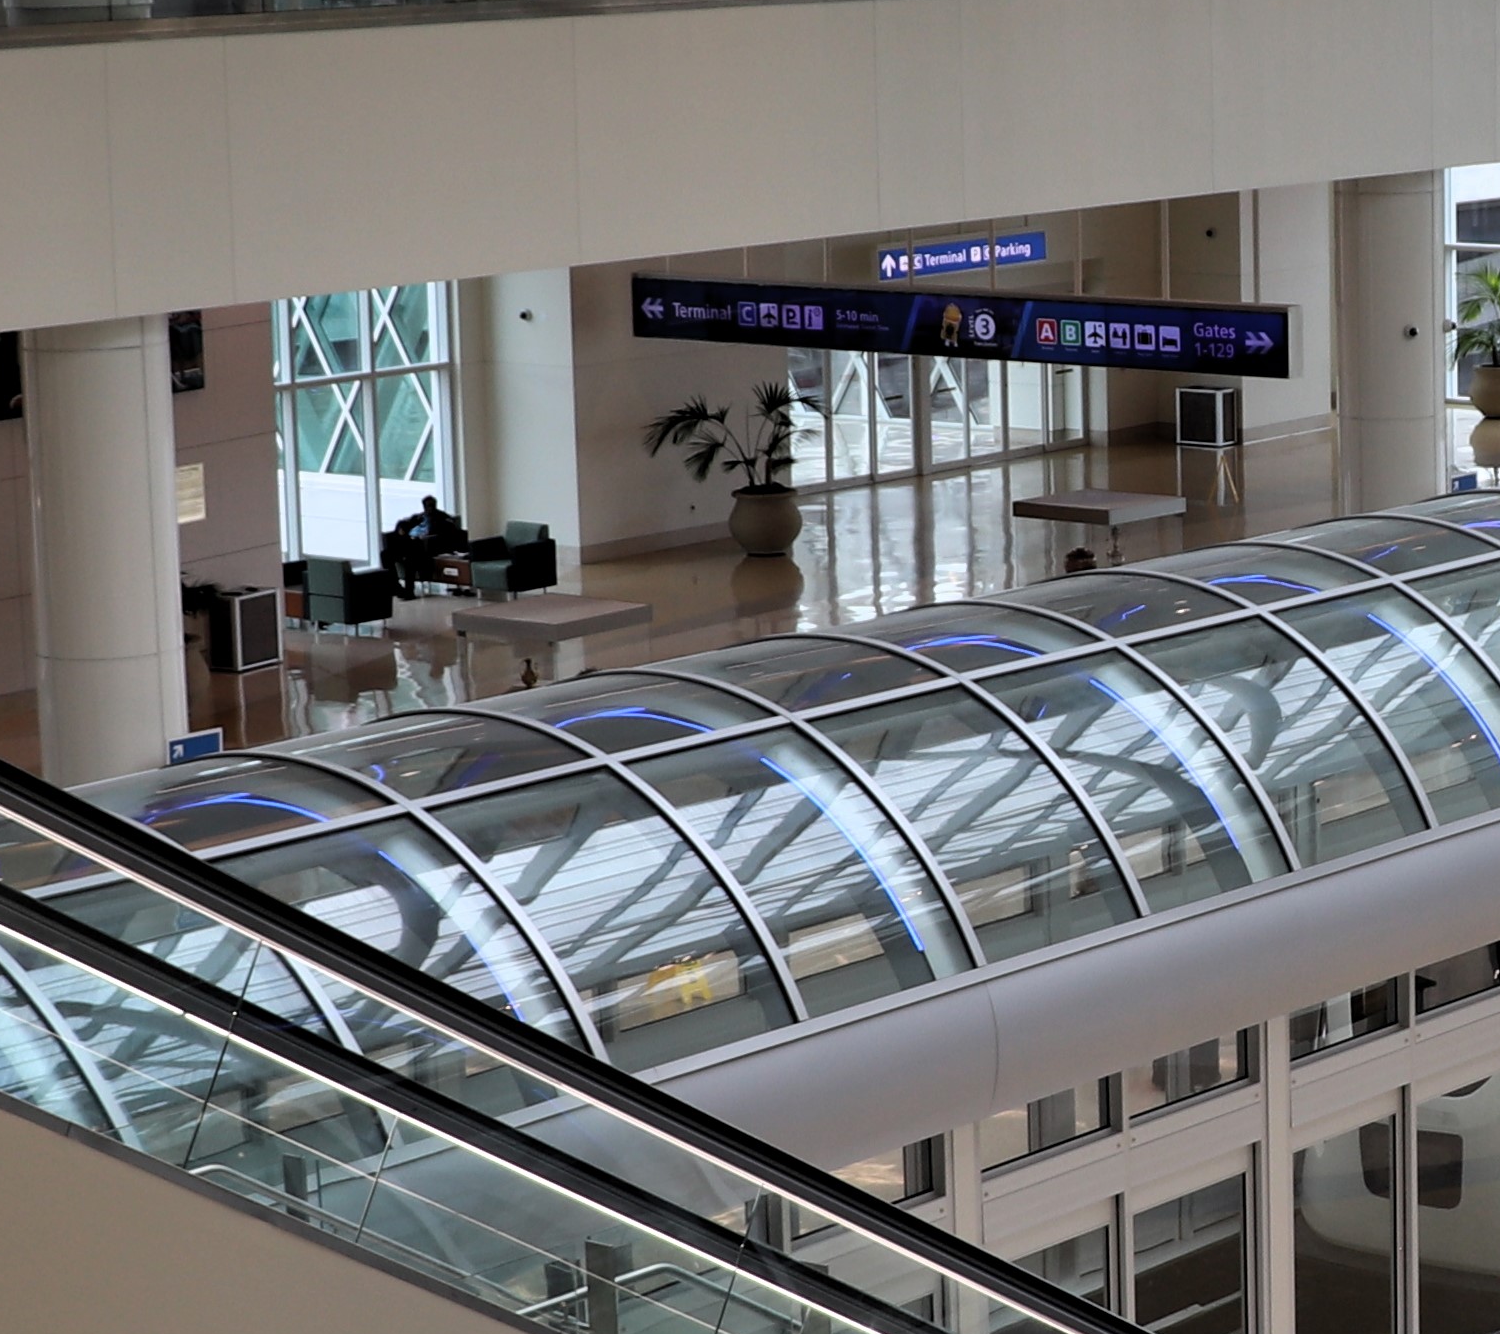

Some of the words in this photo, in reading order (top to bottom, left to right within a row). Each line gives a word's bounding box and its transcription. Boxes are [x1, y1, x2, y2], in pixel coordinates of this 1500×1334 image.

[923, 249, 967, 267] Terminal
[995, 242, 1032, 258] Parking
[672, 301, 731, 321] Terminal
[836, 309, 858, 322] 5-10
[859, 310, 880, 323] min
[980, 317, 990, 336] 3
[1040, 323, 1055, 340] A
[1193, 322, 1237, 340] Gates
[1194, 342, 1235, 359] 1-129
